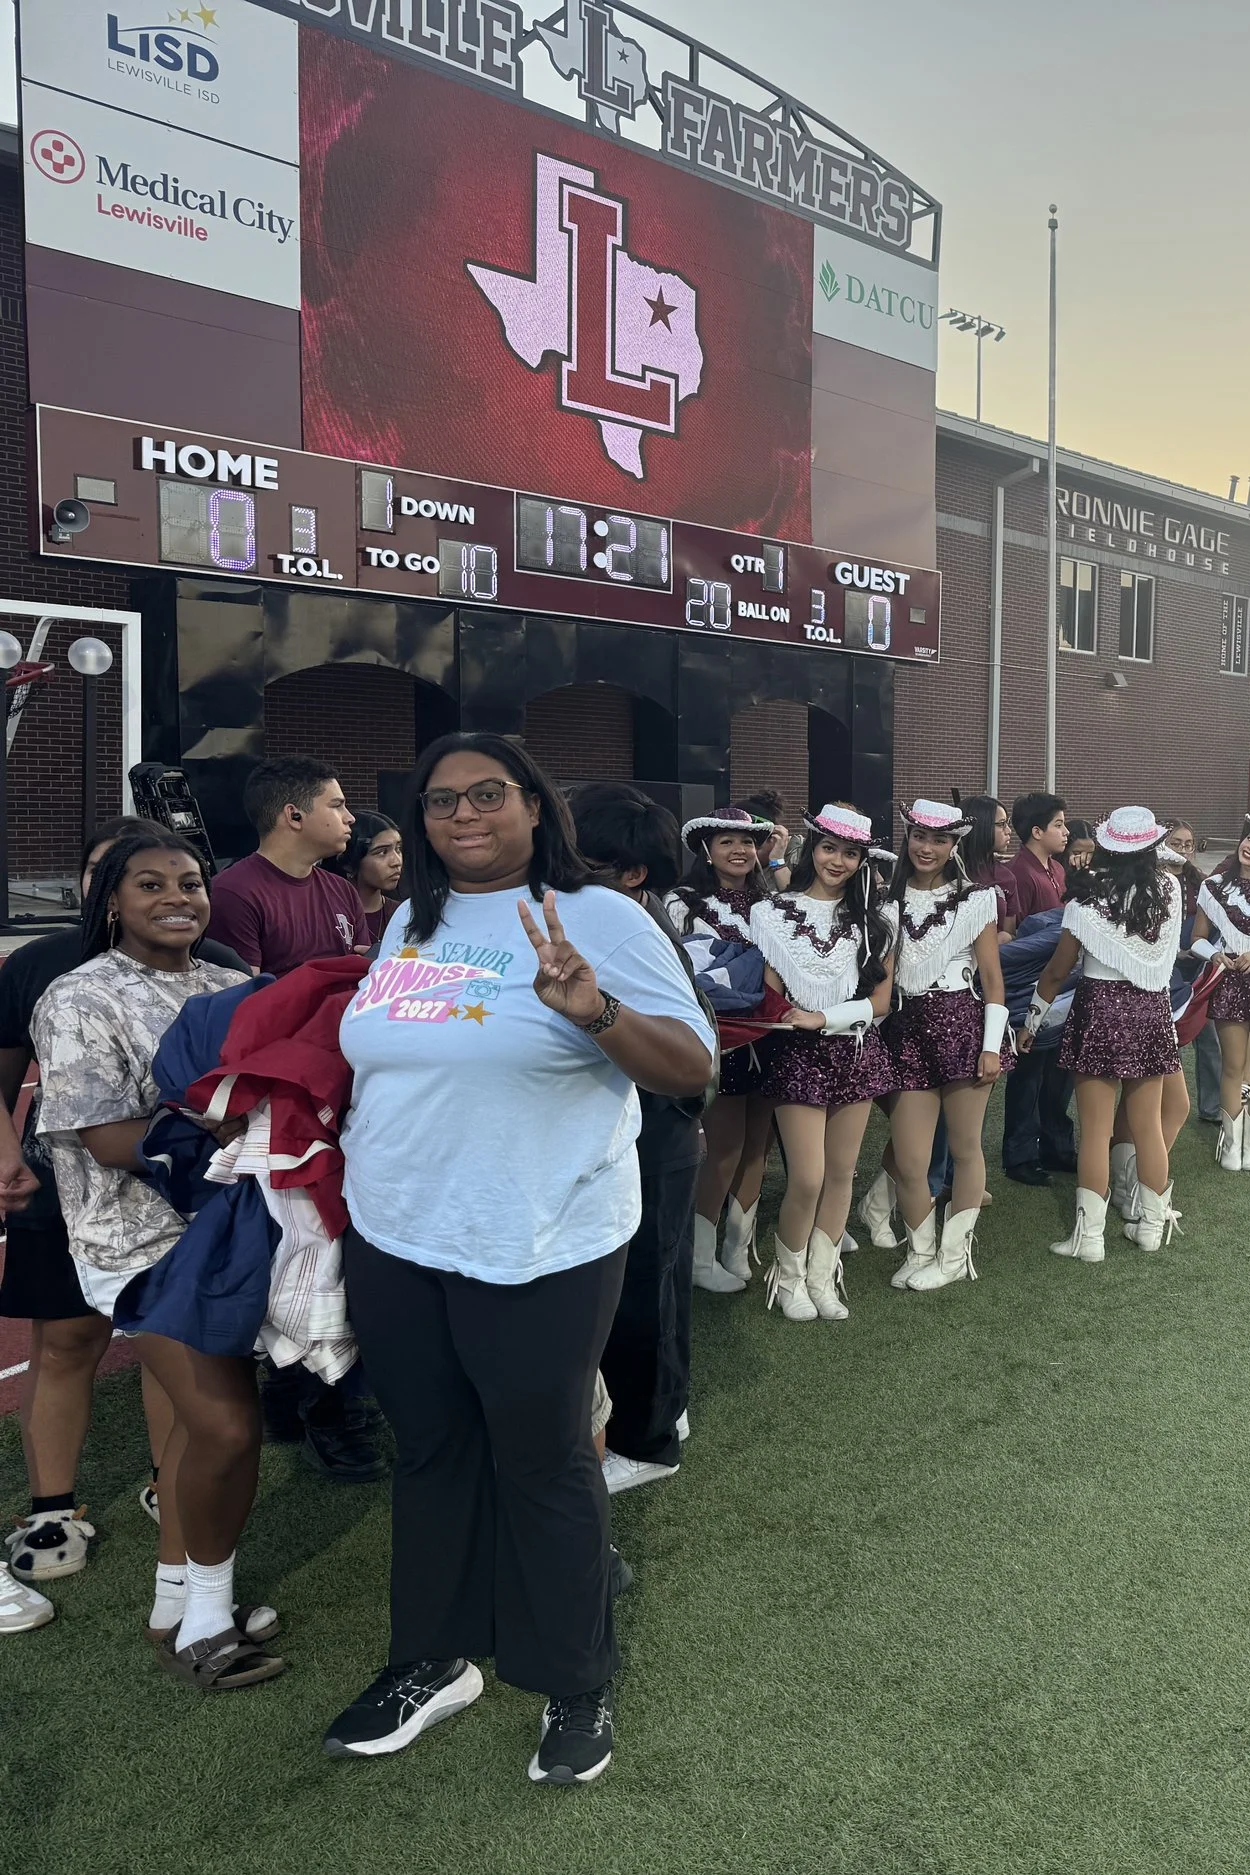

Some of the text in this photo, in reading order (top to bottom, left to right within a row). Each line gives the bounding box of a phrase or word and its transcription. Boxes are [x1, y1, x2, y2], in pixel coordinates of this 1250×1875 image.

[107, 13, 220, 82] LISD
[299, 0, 516, 91] ILLE
[581, 1, 634, 115] L
[107, 58, 220, 105] LEWISVILLE ISD
[667, 80, 909, 247] FARMERS
[96, 155, 294, 243] Medical City
[97, 193, 208, 242] Lewisville
[562, 183, 676, 433] L
[845, 275, 935, 330] DATCU
[141, 436, 279, 490] HOME
[385, 477, 394, 529] 1
[401, 496, 475, 525] DOWN
[1056, 486, 1230, 556] RONNIE GAGE
[209, 489, 256, 572] 0
[293, 504, 316, 555] 3
[545, 506, 668, 583] 17:21
[1056, 519, 1230, 576] IELDHOUSE
[277, 554, 343, 580] T.O.L.
[366, 546, 440, 575] TO GO
[461, 543, 499, 600] 10
[731, 553, 766, 575] QTR
[777, 548, 784, 590] 1
[835, 561, 910, 596] GUEST
[686, 578, 731, 630] 20
[738, 600, 790, 624] BALL ON
[812, 588, 825, 625] 3
[868, 595, 891, 651] 0
[1222, 623, 1228, 636] OF
[803, 624, 841, 644] T.O.L.
[1235, 606, 1243, 665] LEWISVILLE
[437, 941, 514, 976] SENIOR
[355, 958, 485, 1012] SUNRISE
[395, 1000, 447, 1019] 2027
